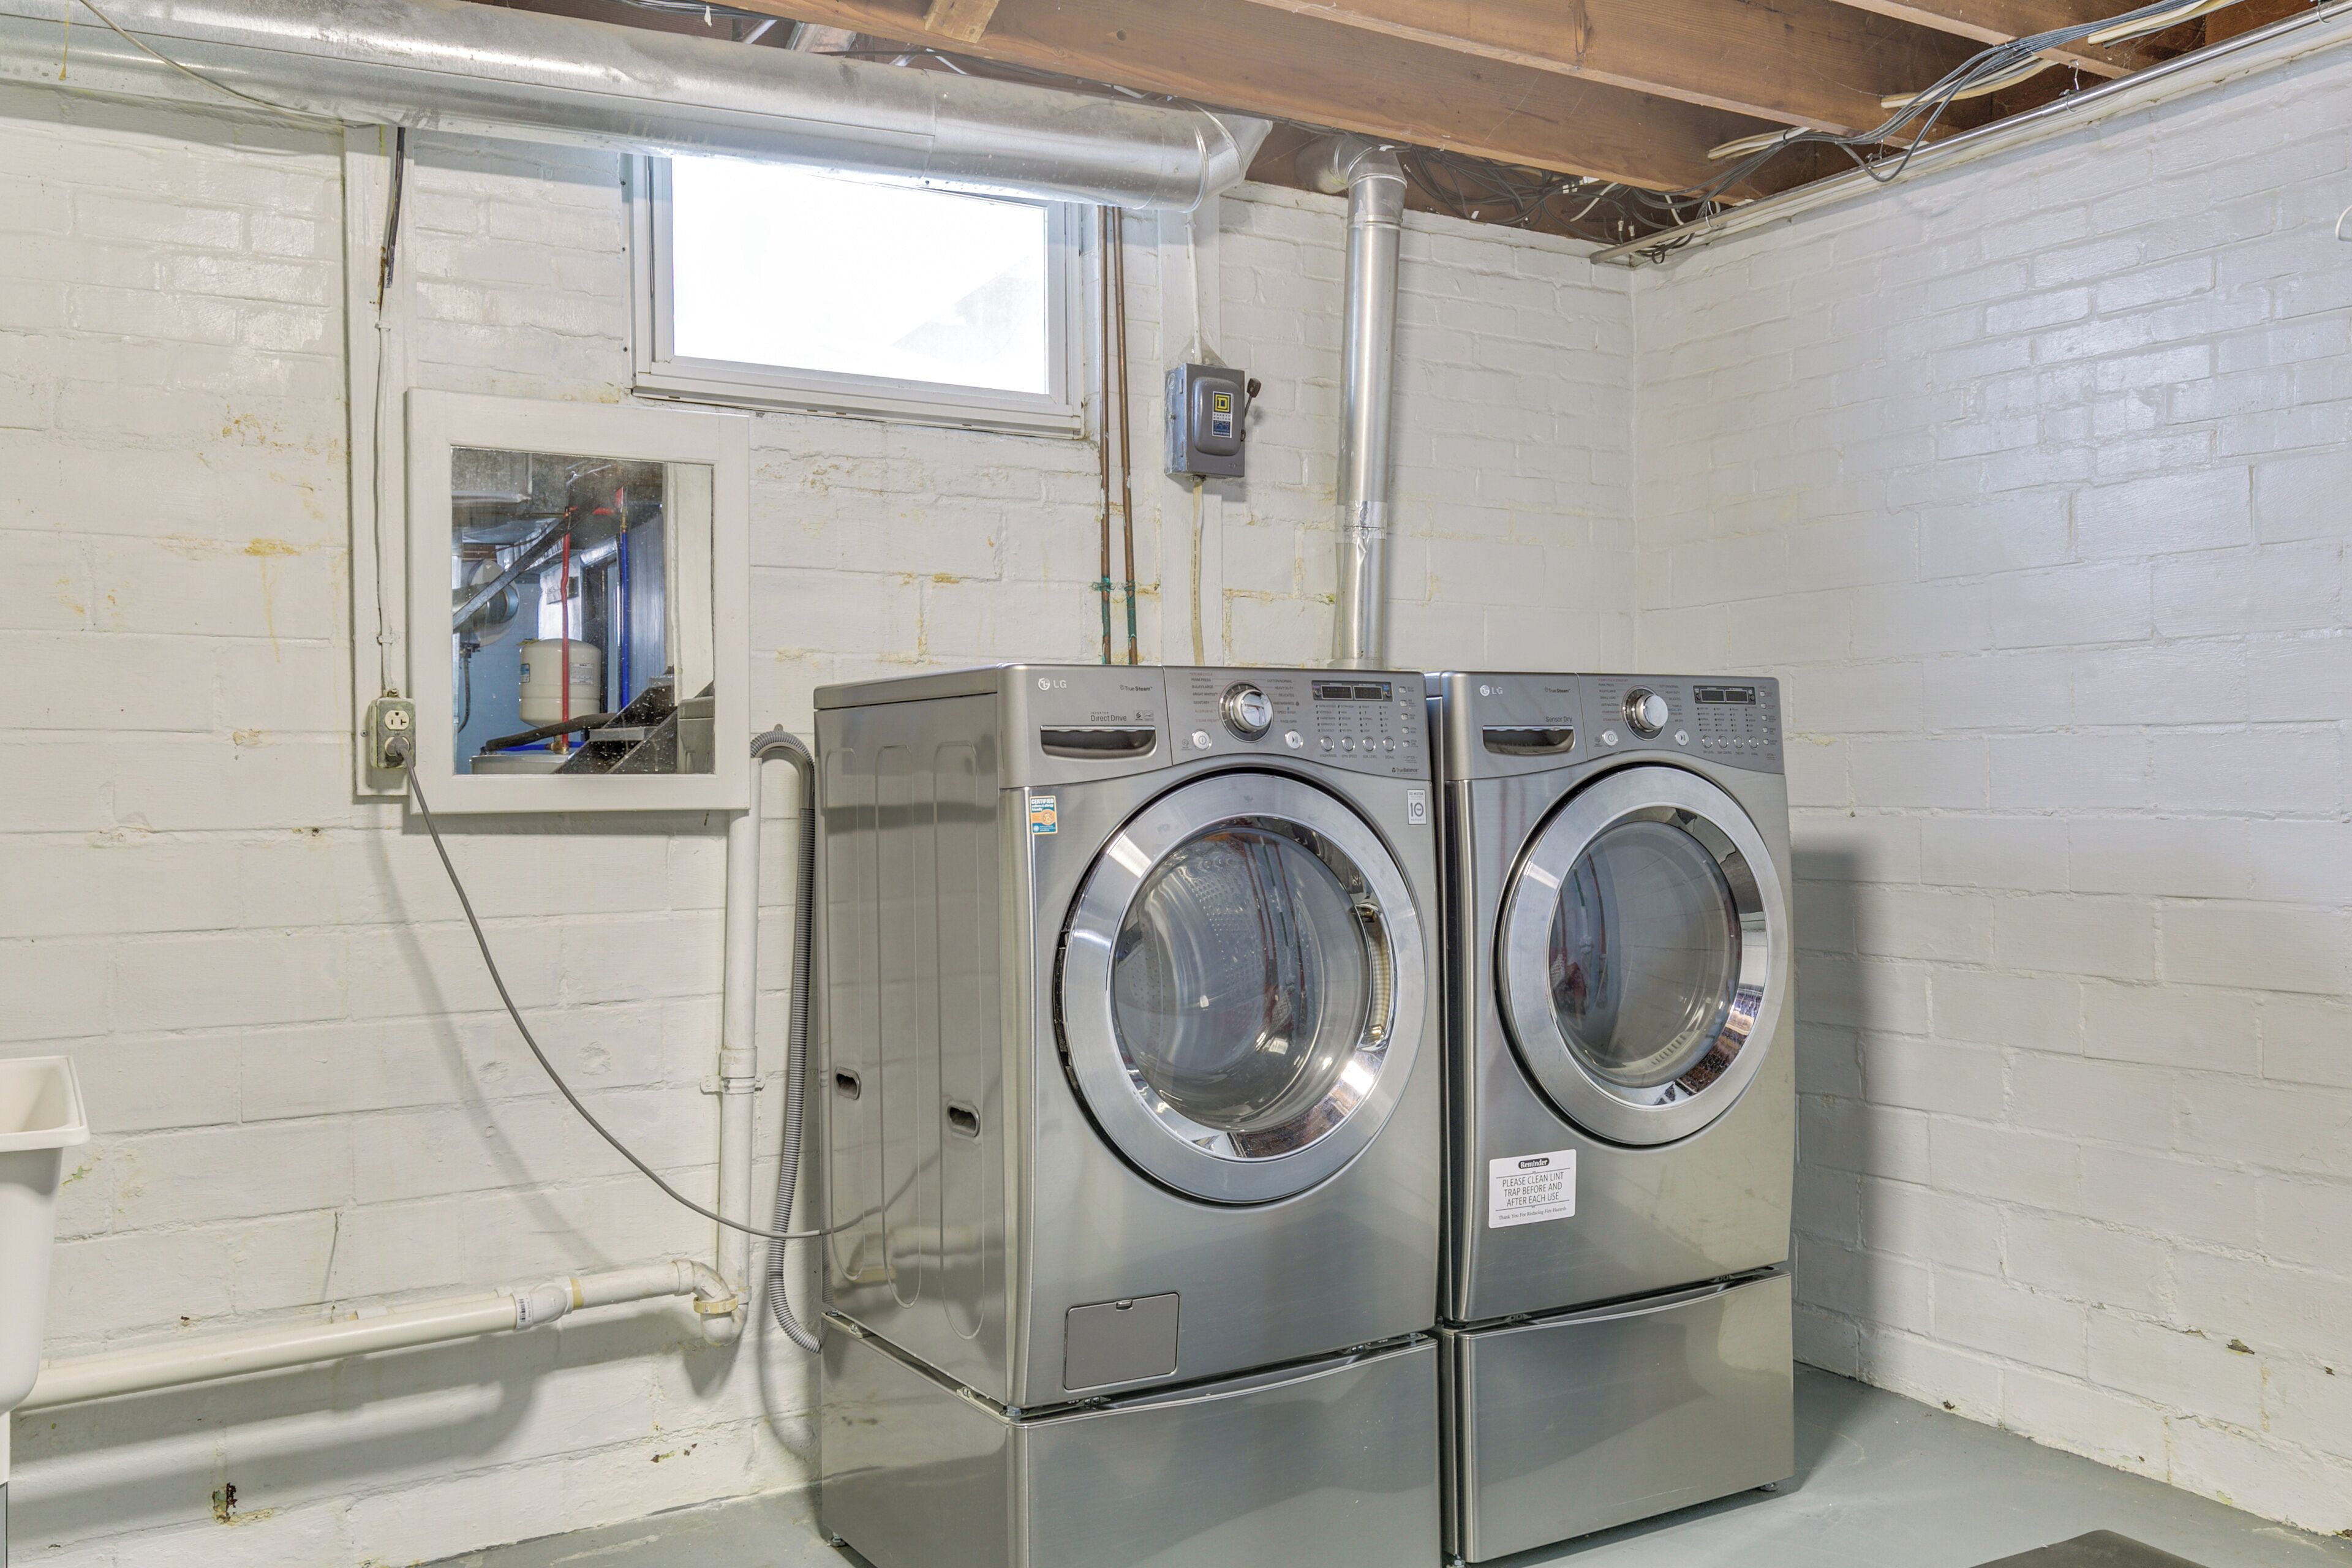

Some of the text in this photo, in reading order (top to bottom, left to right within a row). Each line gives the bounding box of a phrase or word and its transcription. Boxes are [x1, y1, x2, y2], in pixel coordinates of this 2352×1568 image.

[1053, 680, 1067, 689] LG
[1520, 1159, 1548, 1169] Reminder
[1502, 1171, 1564, 1188] PLEASE CLEAN LINT
[1504, 1182, 1562, 1197] TRAP BEFORE AND
[1506, 1191, 1559, 1207] AFTER EACH USE
